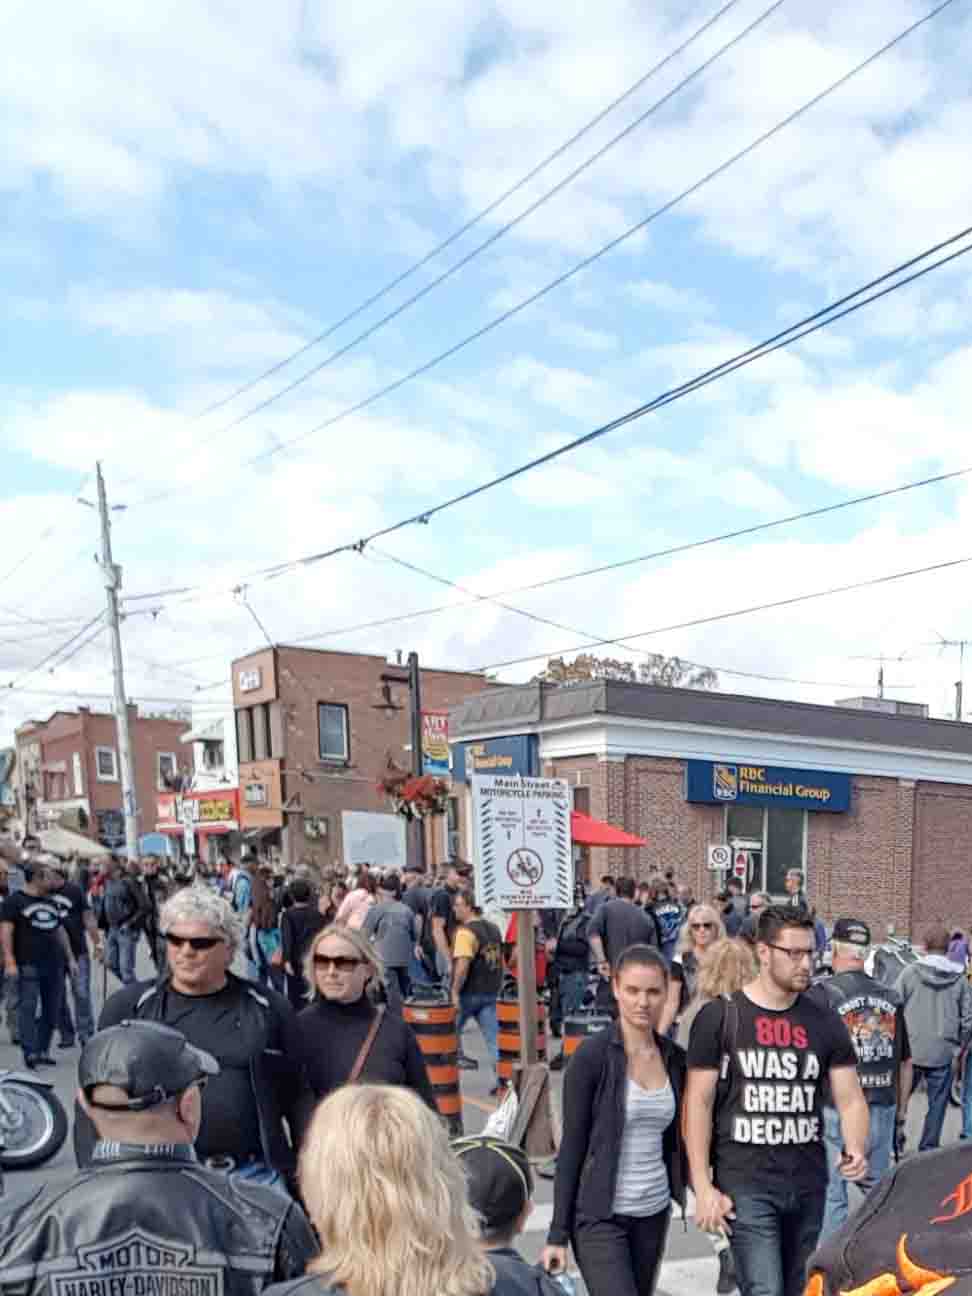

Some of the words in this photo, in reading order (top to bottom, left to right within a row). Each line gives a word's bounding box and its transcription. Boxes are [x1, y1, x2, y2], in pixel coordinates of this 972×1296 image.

[494, 778, 519, 788] Main
[520, 778, 550, 788] Street
[739, 767, 766, 780] RBC
[739, 780, 793, 796] Financial
[795, 785, 831, 801] Group
[755, 1016, 809, 1048] 80s
[737, 1050, 798, 1080] WAS
[802, 1053, 820, 1080] A
[744, 1084, 816, 1113] GREAT
[733, 1117, 820, 1144] DECADE
[99, 1241, 177, 1268] MOTOR
